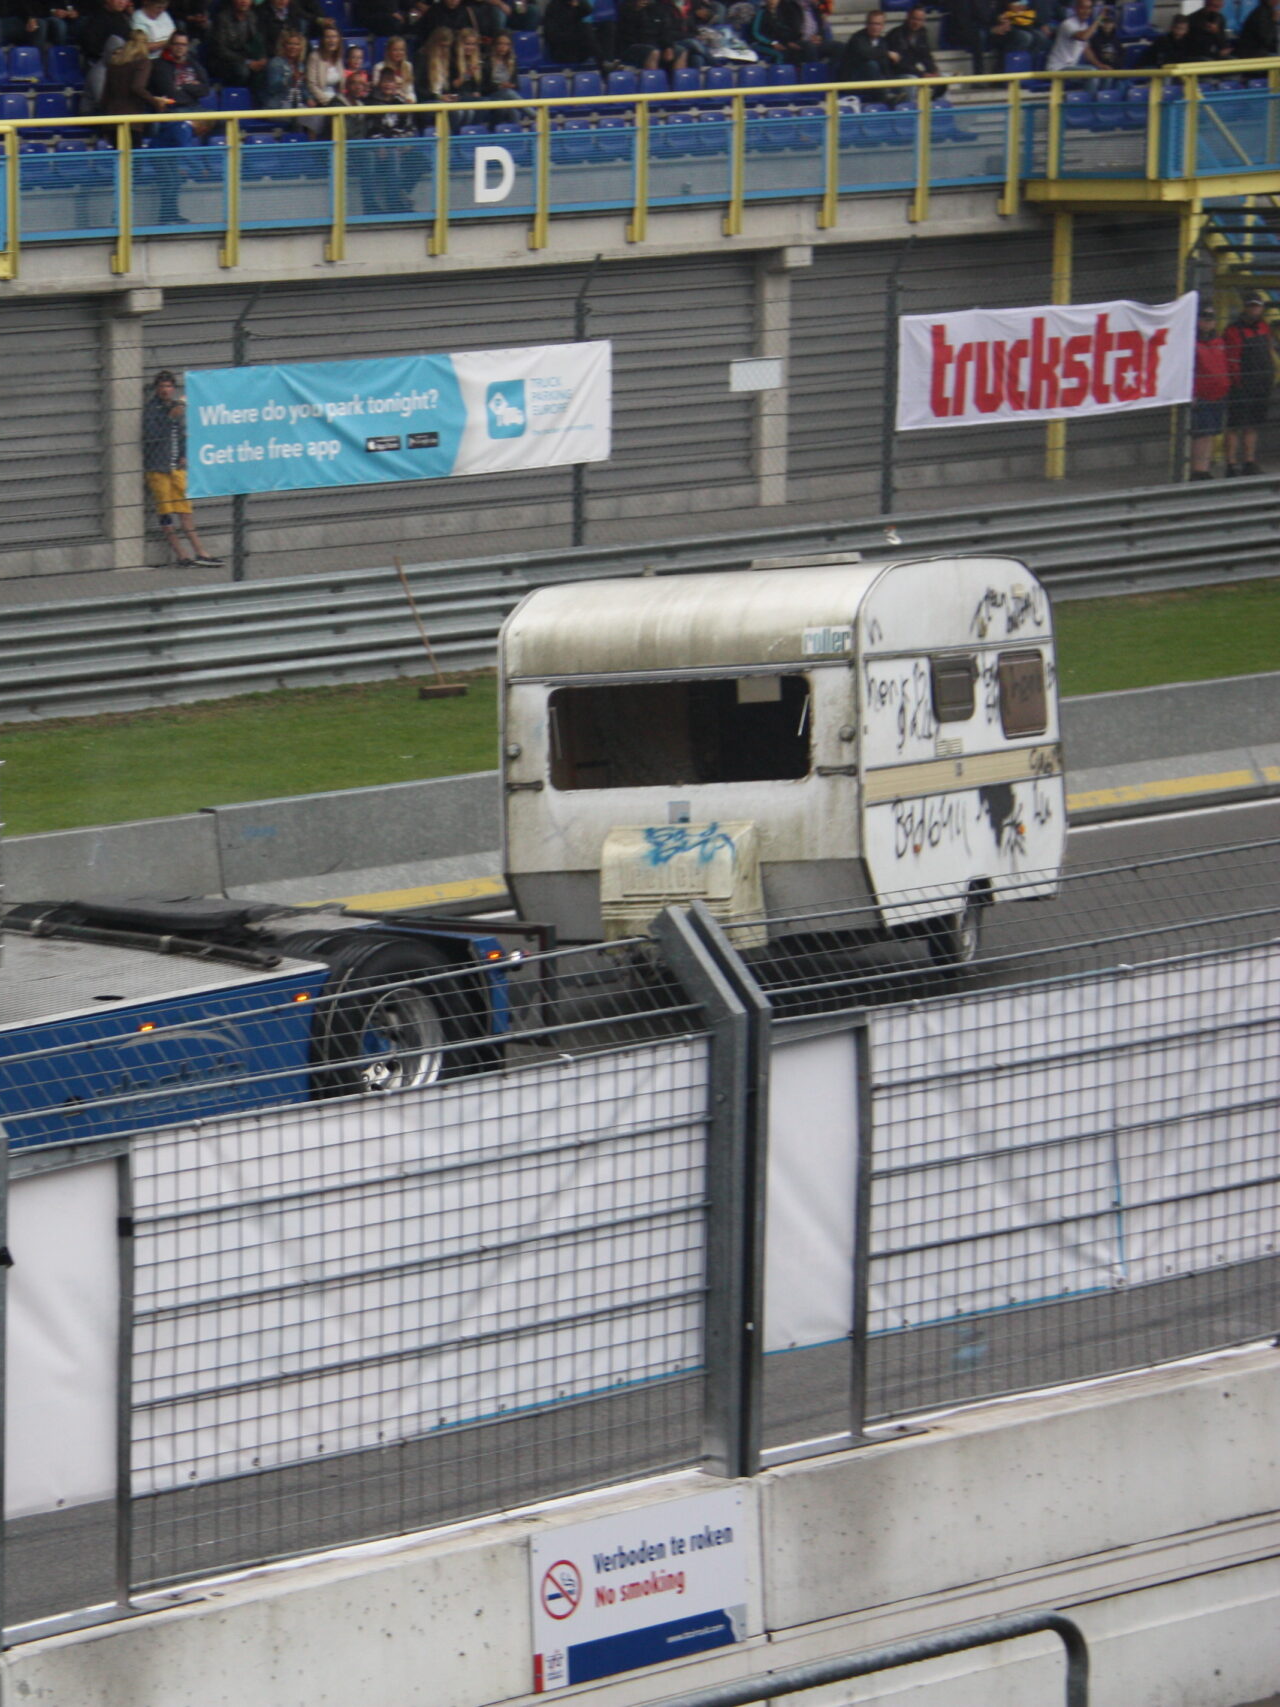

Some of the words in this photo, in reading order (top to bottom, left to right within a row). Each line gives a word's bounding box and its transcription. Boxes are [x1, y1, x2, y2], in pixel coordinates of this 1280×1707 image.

[474, 146, 515, 203] D
[930, 313, 1169, 418] truckstar
[199, 404, 259, 426] Where
[261, 400, 285, 421] do
[288, 403, 324, 425] you
[325, 397, 365, 423] park
[367, 389, 440, 418] tonight?
[199, 443, 234, 466] Get
[235, 440, 266, 462] the
[268, 437, 304, 459] free
[306, 439, 342, 462] app
[804, 628, 850, 654] roller
[593, 1540, 666, 1574] Verboden
[670, 1536, 685, 1556] te
[690, 1525, 733, 1551] roken
[594, 1586, 616, 1607] No
[620, 1570, 685, 1602] smoking
